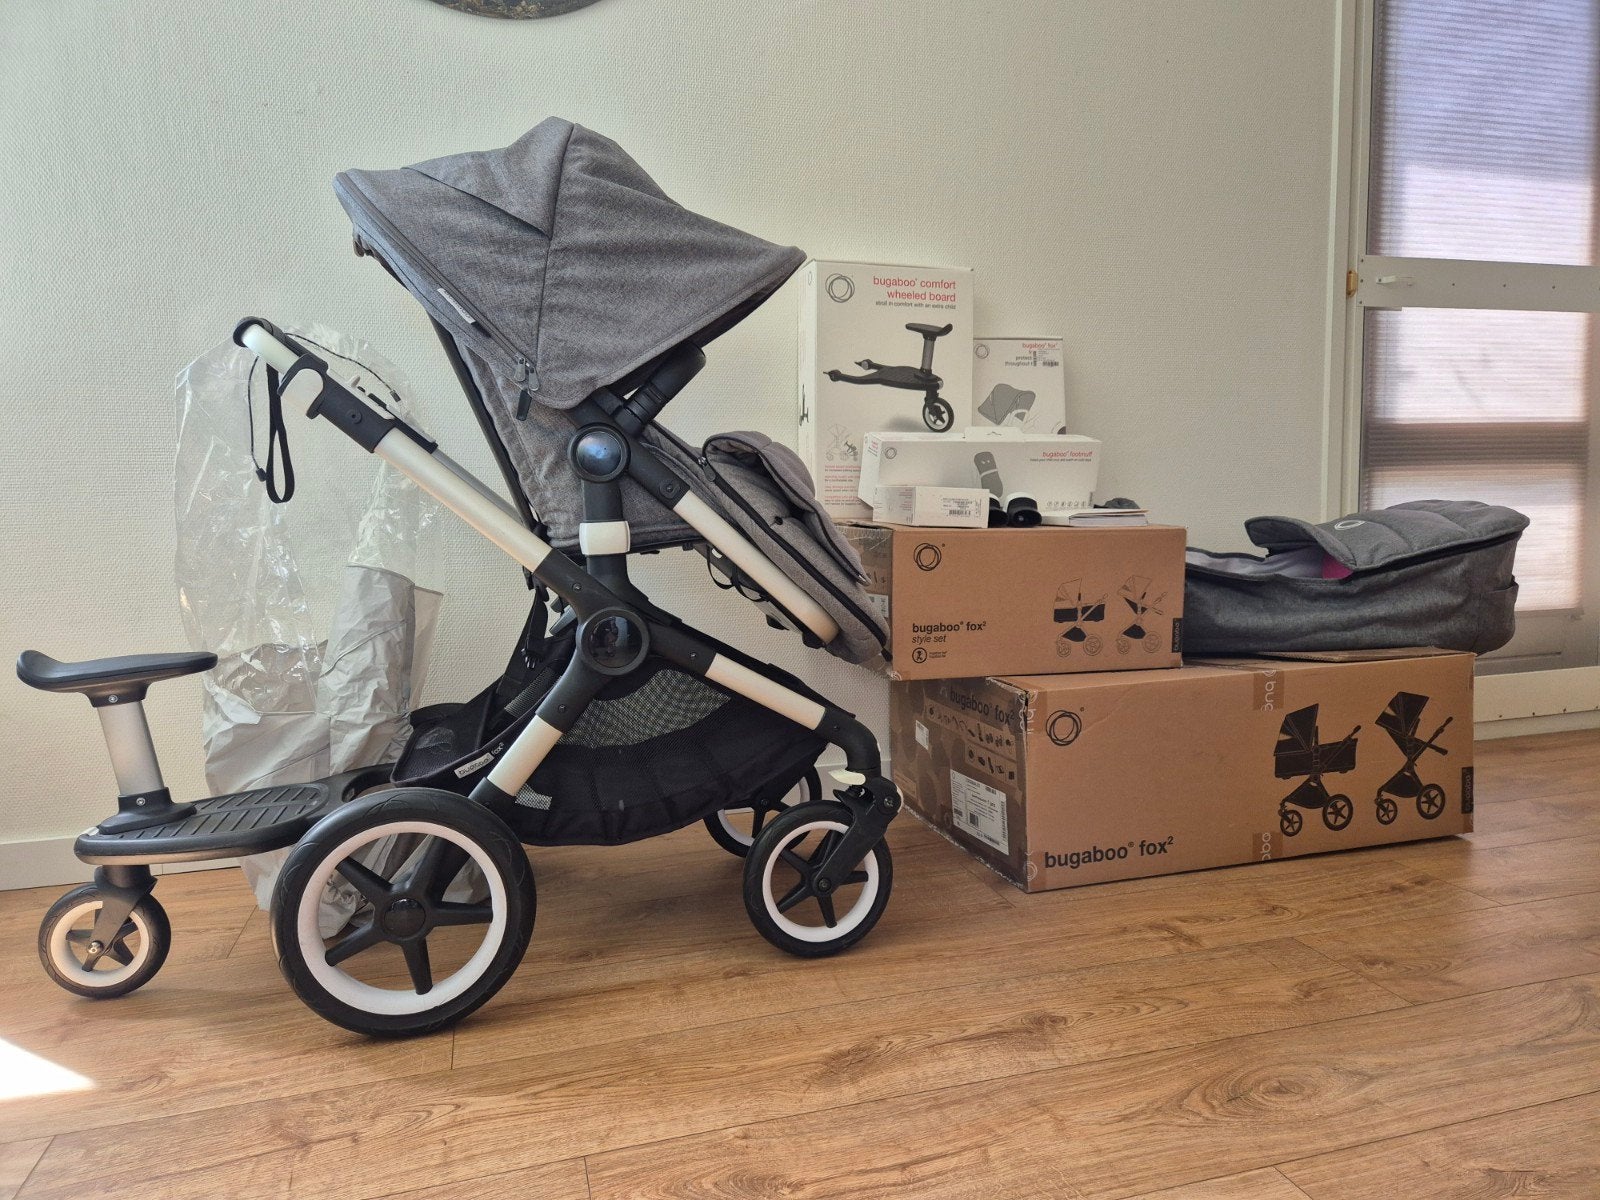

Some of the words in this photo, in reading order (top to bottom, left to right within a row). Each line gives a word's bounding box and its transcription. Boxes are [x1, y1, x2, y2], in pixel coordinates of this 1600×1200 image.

[920, 280, 956, 290] comfort
[887, 290, 926, 301] wheeled
[929, 292, 956, 302] board
[912, 635, 931, 645] style
[933, 634, 946, 643] set
